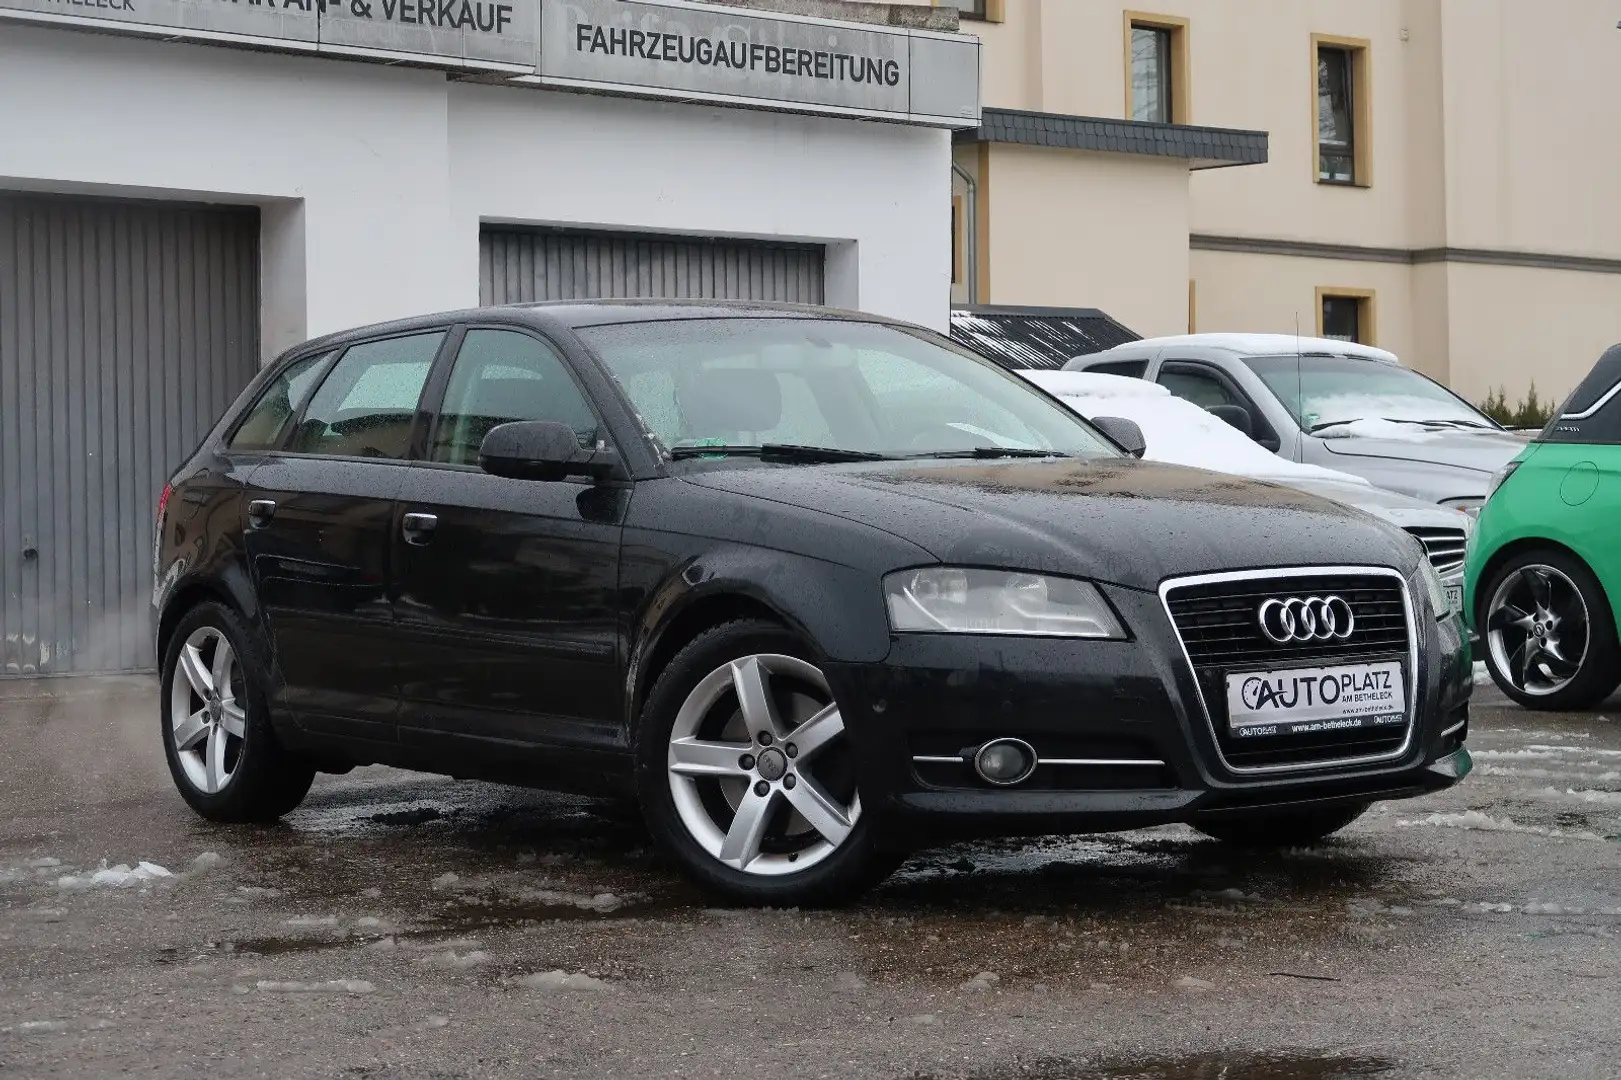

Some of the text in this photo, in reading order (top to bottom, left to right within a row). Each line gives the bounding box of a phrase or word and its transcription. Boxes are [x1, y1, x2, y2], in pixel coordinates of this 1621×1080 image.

[382, 0, 512, 33] VERKAUF
[577, 23, 900, 87] FAHRZEUGAUFBEREITUNG
[1342, 692, 1393, 703] AM BETHELECK
